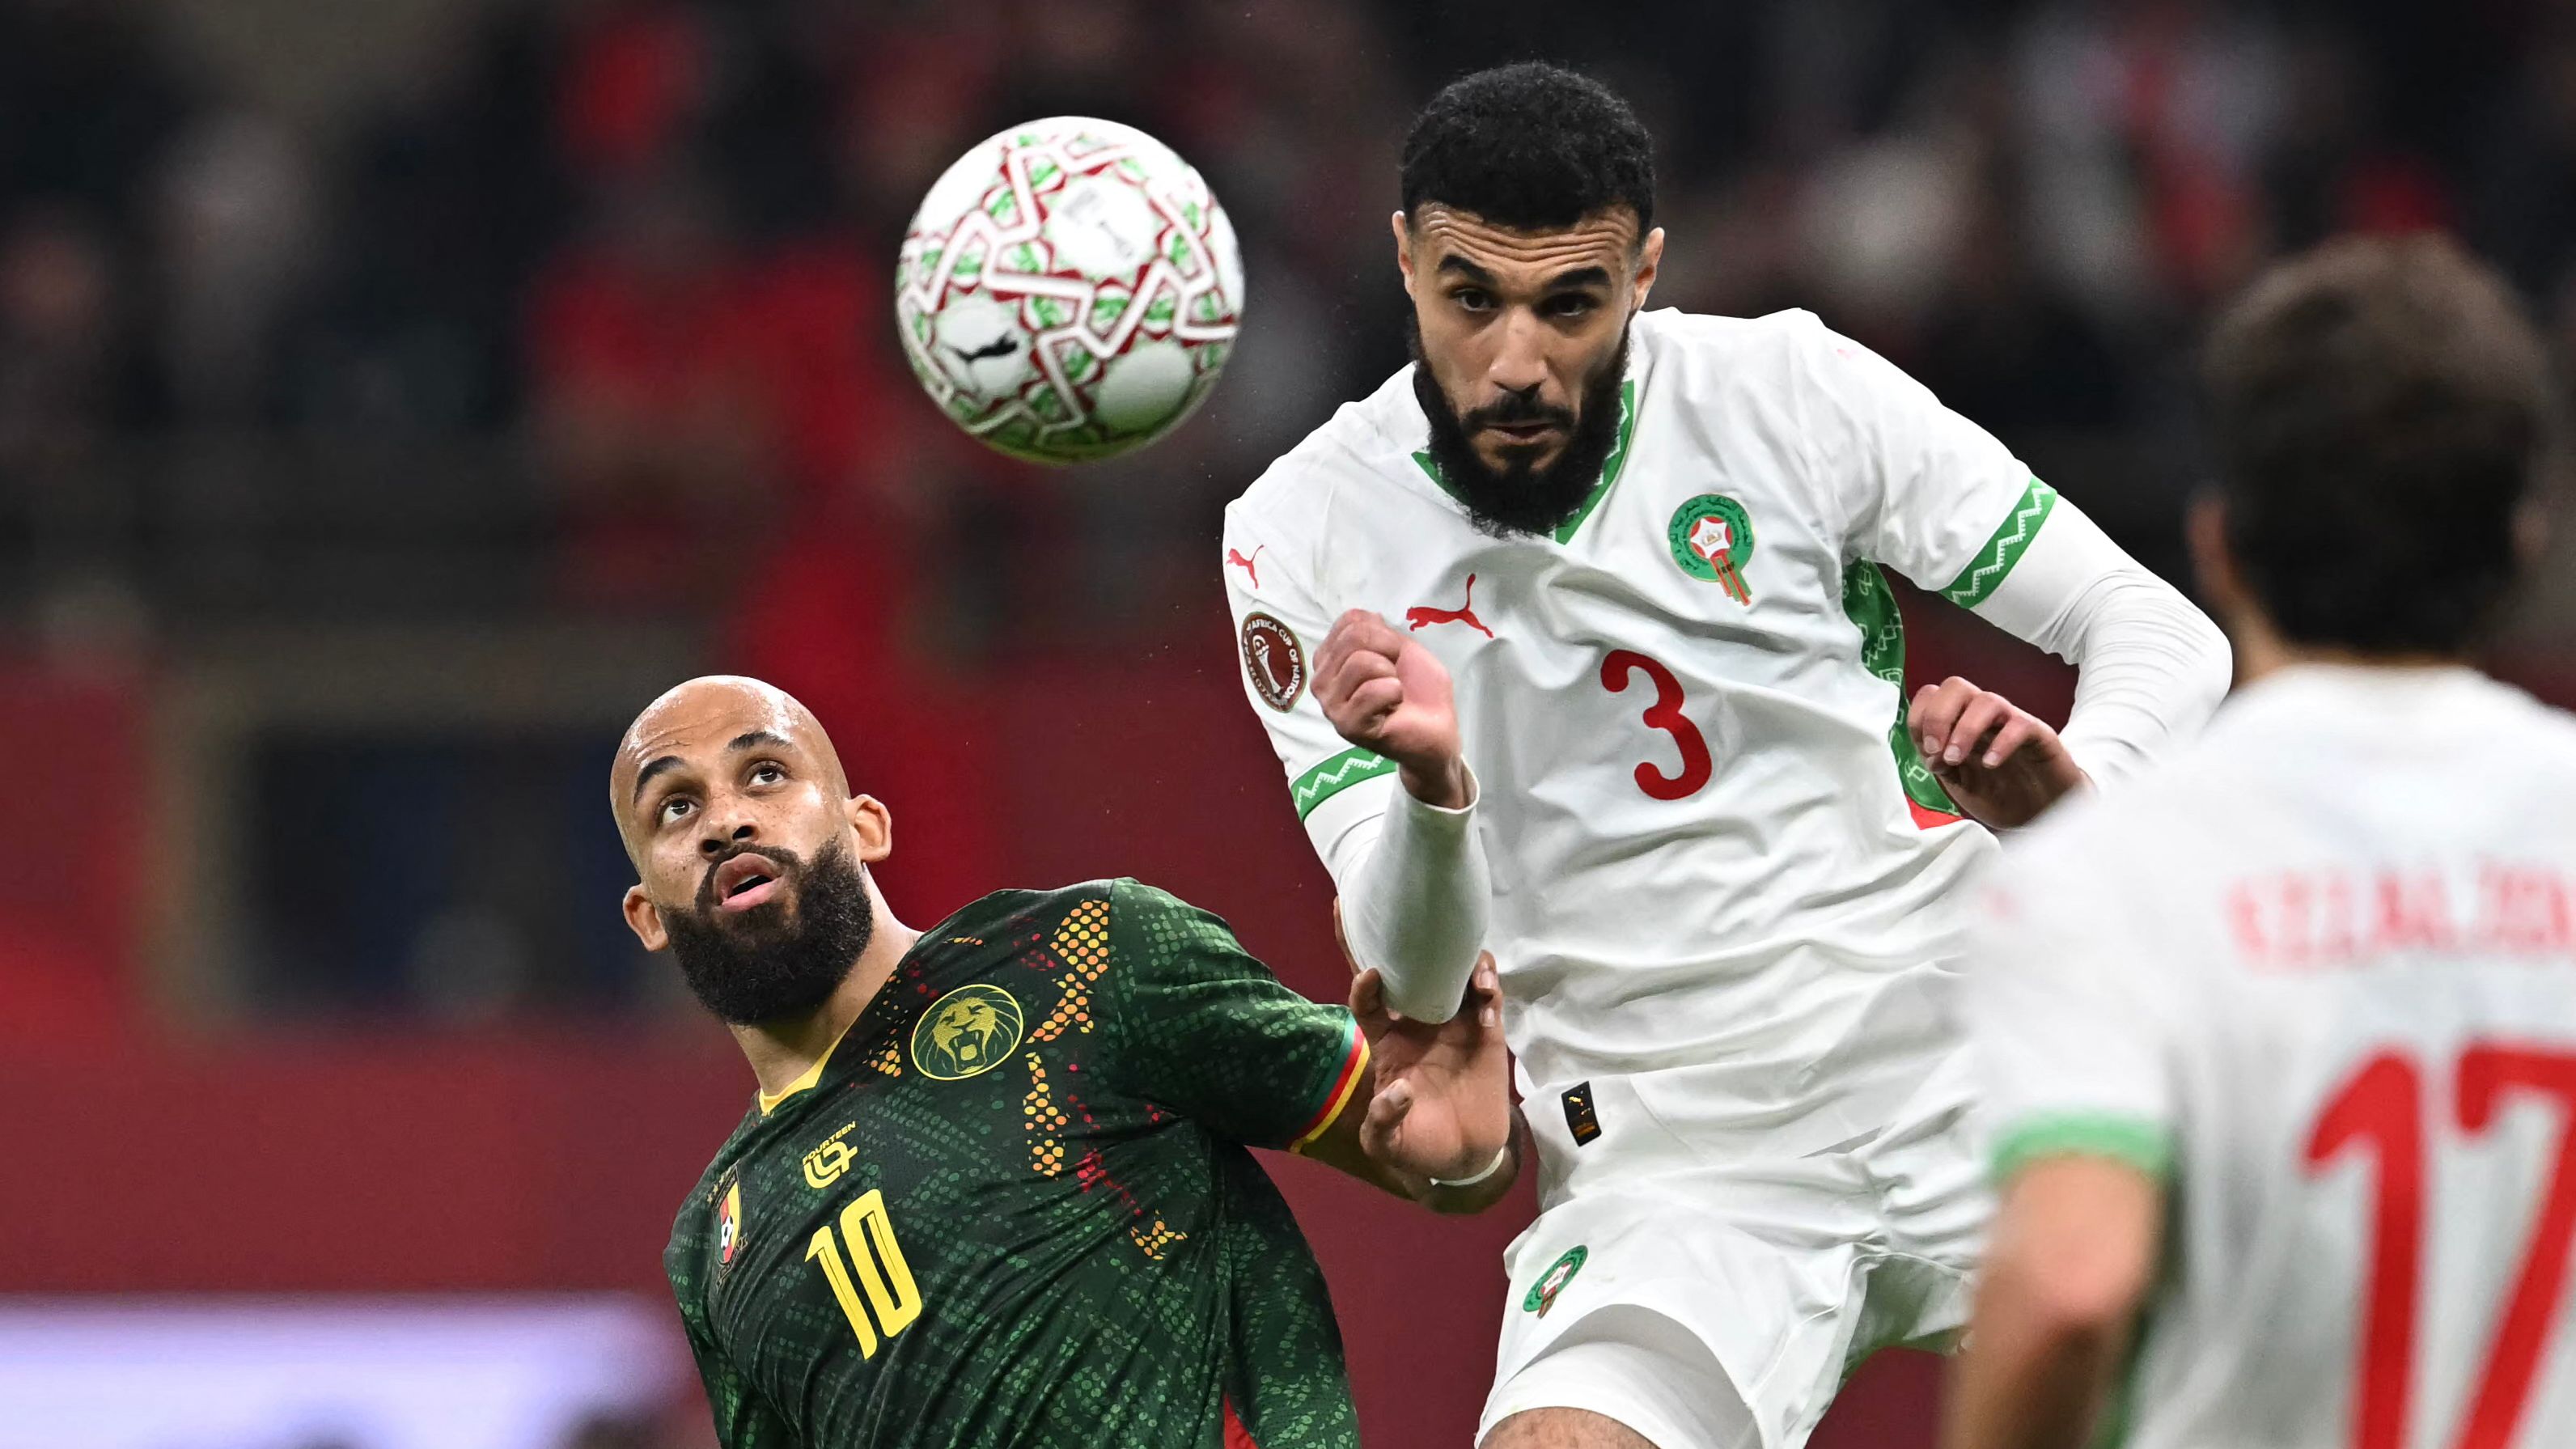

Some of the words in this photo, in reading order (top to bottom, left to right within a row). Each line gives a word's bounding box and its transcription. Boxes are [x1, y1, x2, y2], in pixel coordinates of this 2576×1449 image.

[1251, 619, 1277, 632] AFRICA
[1278, 629, 1293, 646] CUP
[1289, 648, 1299, 663] OF
[1601, 650, 1712, 801] 3
[803, 1121, 856, 1165] FOURTEEN
[804, 1189, 923, 1361] 10
[2300, 1040, 2576, 1449] 17
